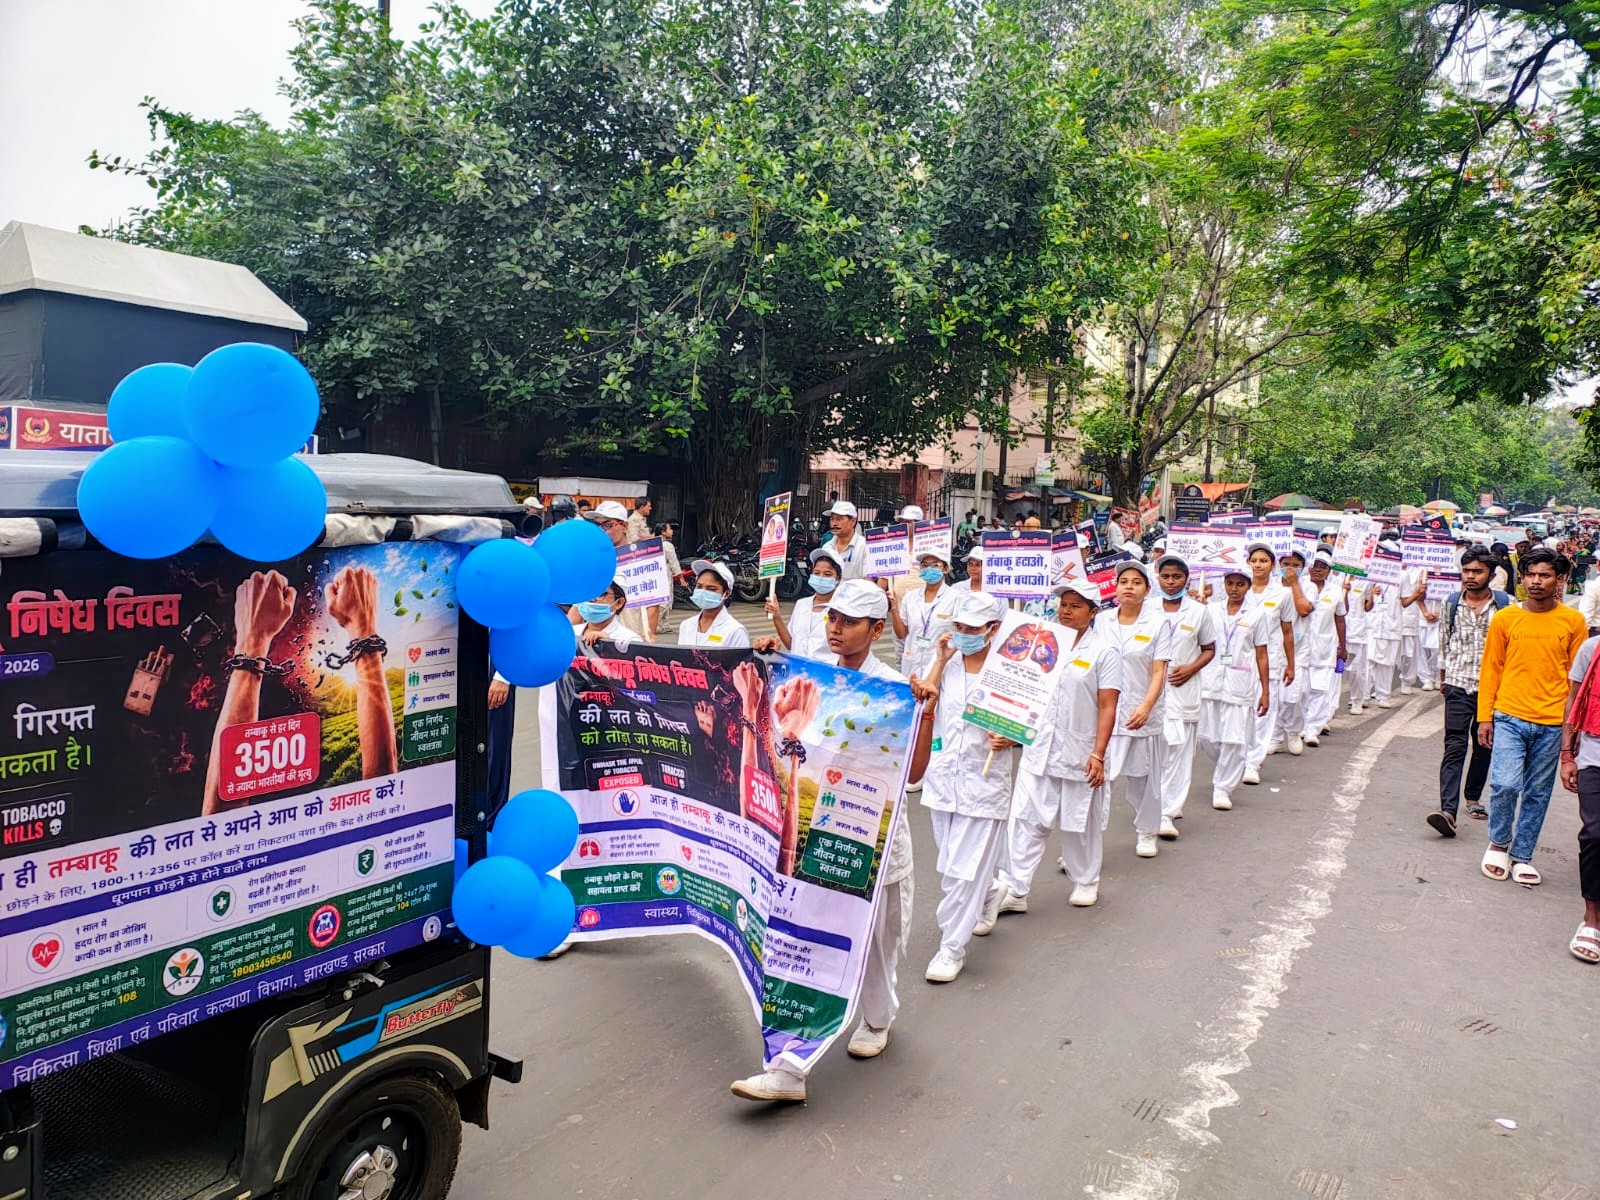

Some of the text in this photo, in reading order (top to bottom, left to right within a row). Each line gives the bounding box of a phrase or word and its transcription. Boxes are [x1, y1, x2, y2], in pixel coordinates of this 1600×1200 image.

[59, 423, 113, 444] याता
[1172, 538, 1199, 546] WORLD
[986, 554, 1048, 571] तंबाकू हटाओ,
[985, 572, 1049, 586] जीवन बचाओ।
[7, 586, 182, 638] निषेध दिवस
[4, 659, 39, 674] 2026
[635, 656, 671, 684] निषेध
[670, 660, 709, 689] दिवस
[13, 703, 95, 739] गिरफ्त
[270, 722, 277, 734] से
[278, 723, 287, 734] हर
[288, 718, 300, 731] दिन
[579, 704, 691, 735] की लत की गिरफ्त
[410, 731, 428, 742] जीवन
[440, 724, 449, 736] की
[580, 727, 599, 746] को
[605, 726, 630, 747] तोड़ा
[633, 733, 648, 746] जा
[650, 733, 679, 751] सकता
[235, 733, 306, 777] 3500
[227, 782, 234, 794] से
[287, 769, 296, 780] की
[604, 777, 639, 788] EXPOSED
[1, 800, 66, 826] TOBACCO
[650, 794, 668, 808] आज
[670, 797, 679, 811] ही
[681, 802, 712, 825] तम्बाकू
[714, 811, 725, 827] की
[728, 819, 741, 834] लत
[4, 821, 44, 844] KILLS
[14, 861, 37, 888] ही
[48, 847, 120, 878] तम्बाकू
[130, 835, 156, 858] की
[164, 831, 194, 851] लत
[201, 821, 217, 842] से
[224, 810, 262, 837] अपने
[268, 806, 298, 827] आप
[304, 797, 323, 818] को
[329, 789, 372, 812] आजाद
[376, 780, 395, 800] करें
[819, 836, 858, 855] एक निर्णय
[43, 891, 55, 902] के
[60, 885, 86, 899] लिए,
[91, 862, 180, 890] 1800-11-2356
[184, 857, 197, 868] पर
[201, 850, 223, 863] कॉल
[226, 844, 241, 856] करें
[243, 841, 255, 851] या
[298, 826, 316, 838] नशा
[814, 847, 863, 870] जीवन भर की
[820, 862, 851, 879] स्वतंत्रता
[154, 876, 184, 893] छोड़ने
[187, 873, 198, 883] से
[201, 866, 220, 881] होने
[223, 860, 244, 874] वाले
[248, 855, 268, 868] लाभ
[83, 922, 99, 933] साल
[95, 933, 107, 943] रोग
[110, 930, 119, 938] का
[122, 922, 147, 935] जोखिम
[75, 949, 96, 962] काफी
[98, 946, 112, 956] कम
[114, 941, 122, 952] हो
[124, 936, 141, 948] जाता
[118, 991, 137, 1005] 108
[13, 941, 386, 1087] चिकित्सा शिक्षा एवं परिवार कल्याण विभाग, झारखण्ड सरकार
[386, 998, 456, 1035] Butterfly
